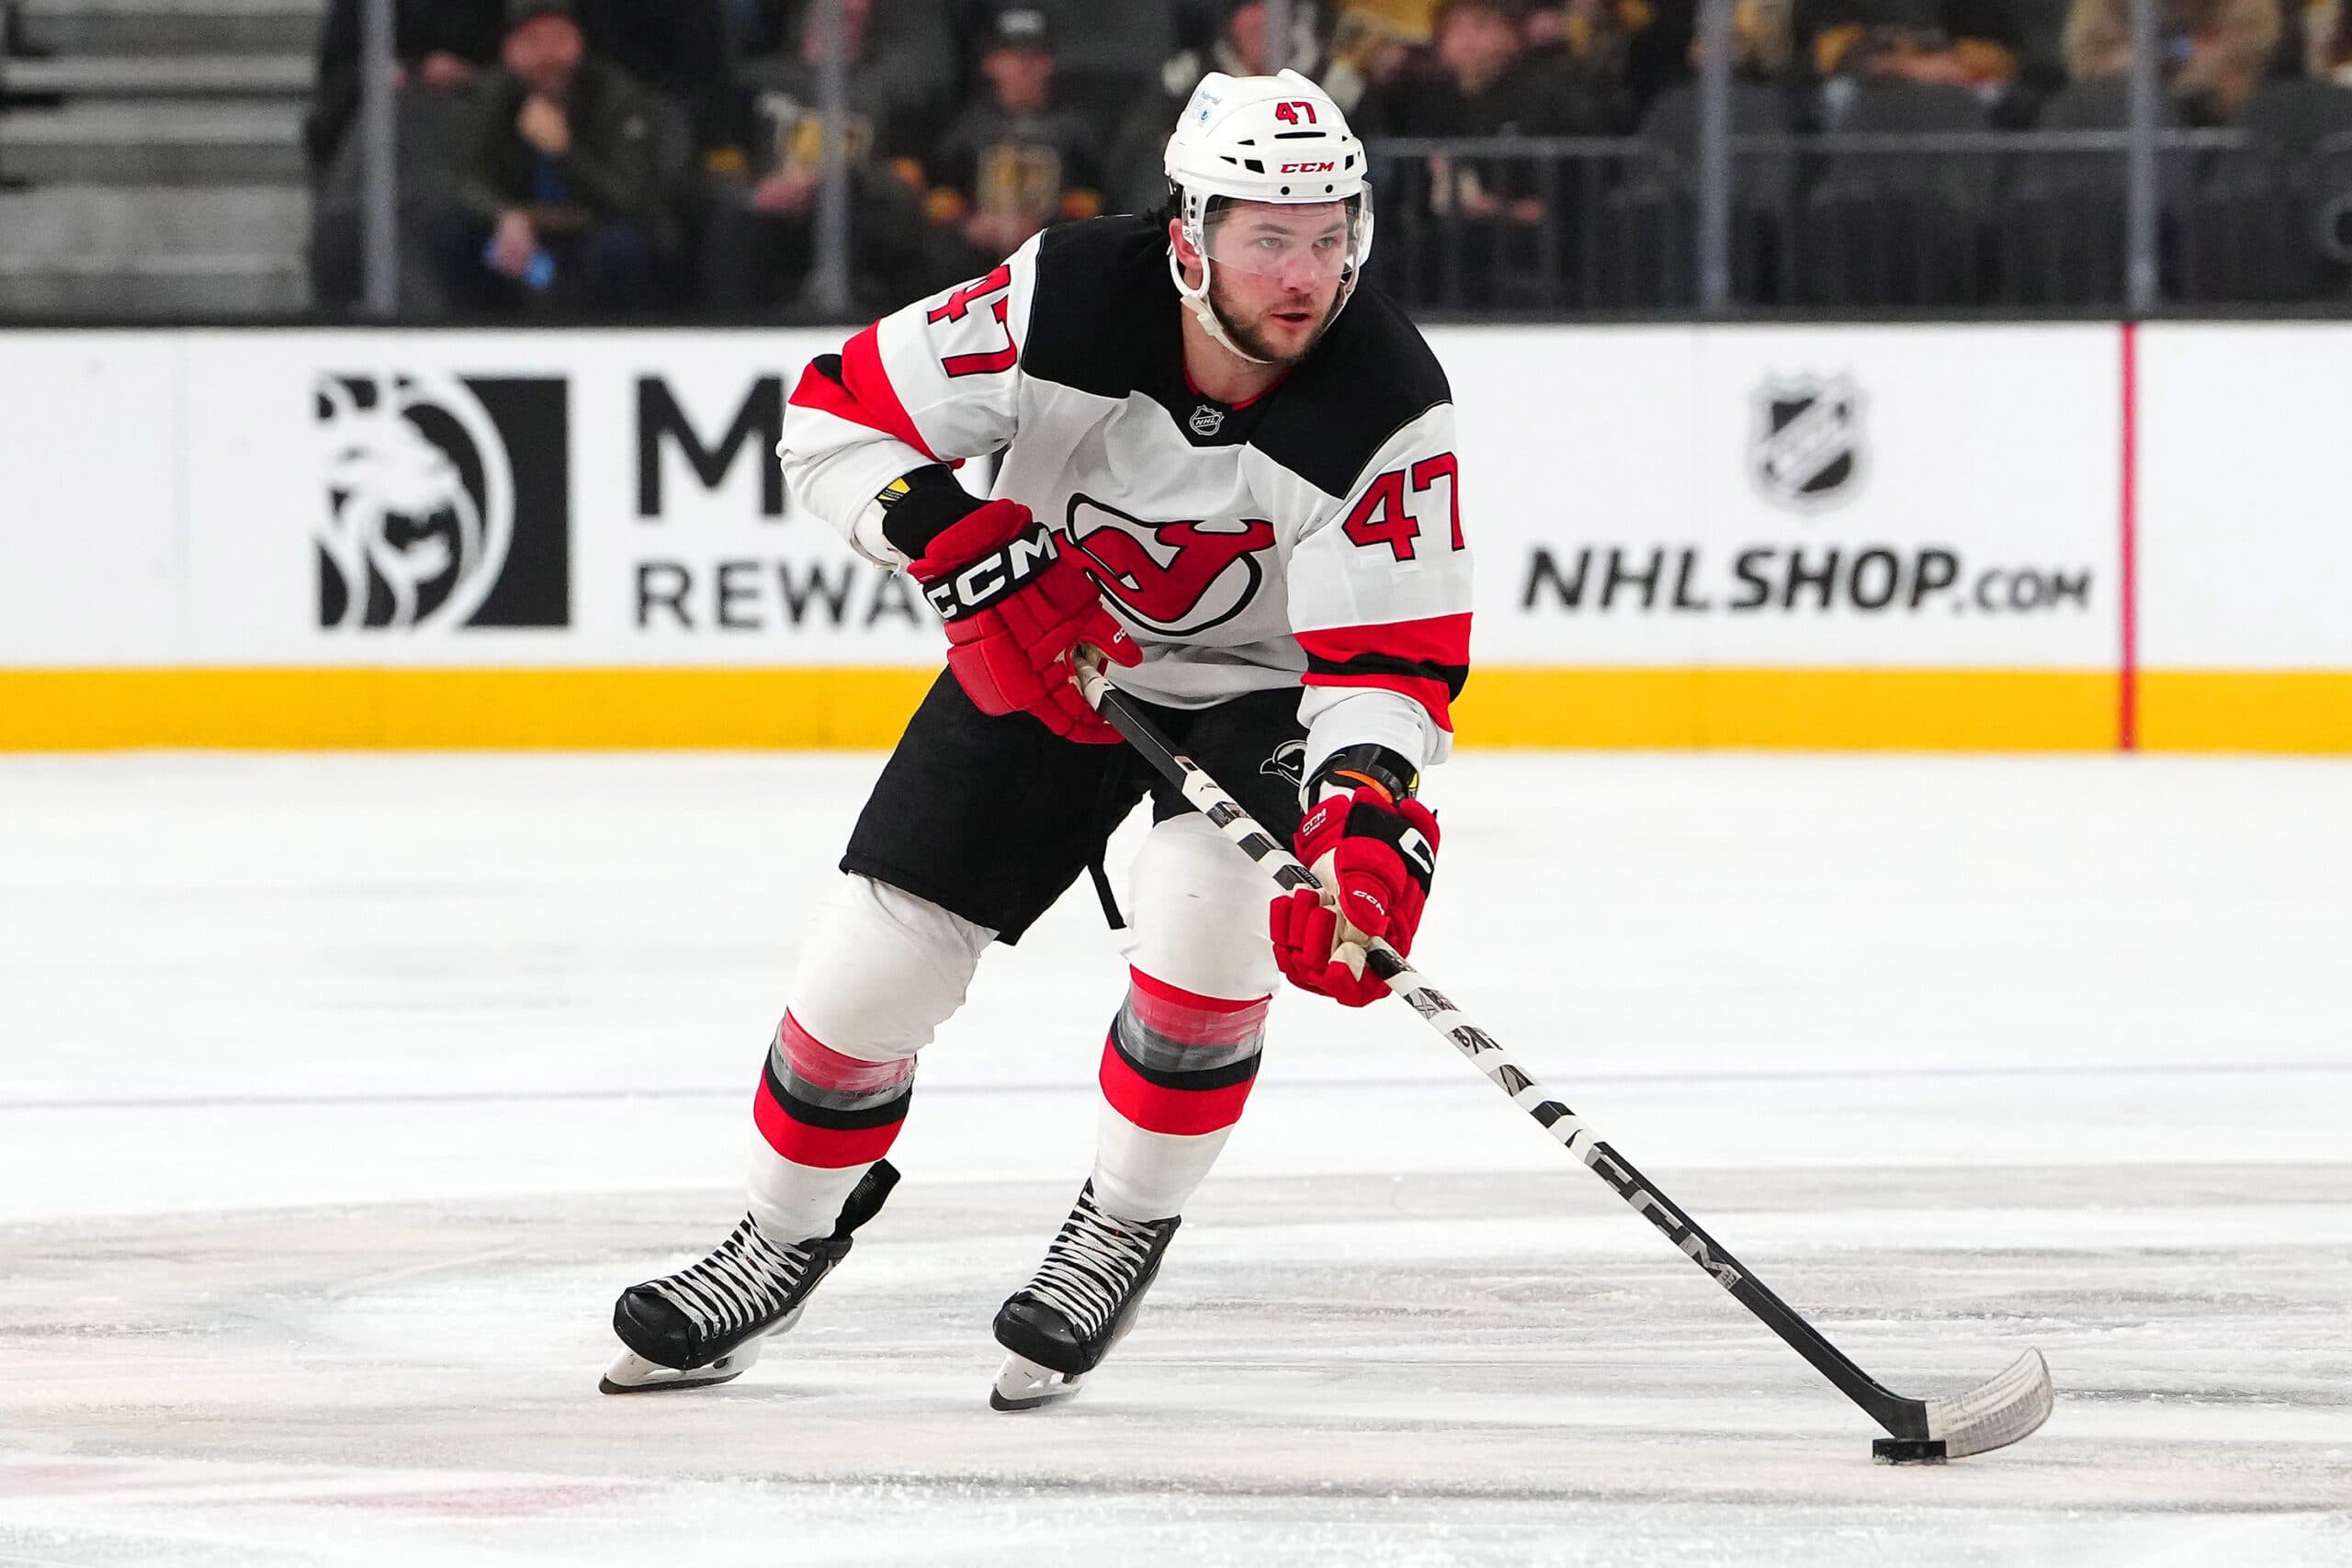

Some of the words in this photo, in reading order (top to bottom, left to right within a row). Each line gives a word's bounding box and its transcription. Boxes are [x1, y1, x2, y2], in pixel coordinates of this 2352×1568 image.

[1275, 101, 1317, 125] 47
[1281, 162, 1335, 174] CCM
[927, 264, 1018, 378] 47
[1341, 451, 1465, 562] 47
[927, 527, 1058, 619] CCM
[1352, 890, 1385, 916] CCM
[1584, 1145, 1744, 1290] CCM
